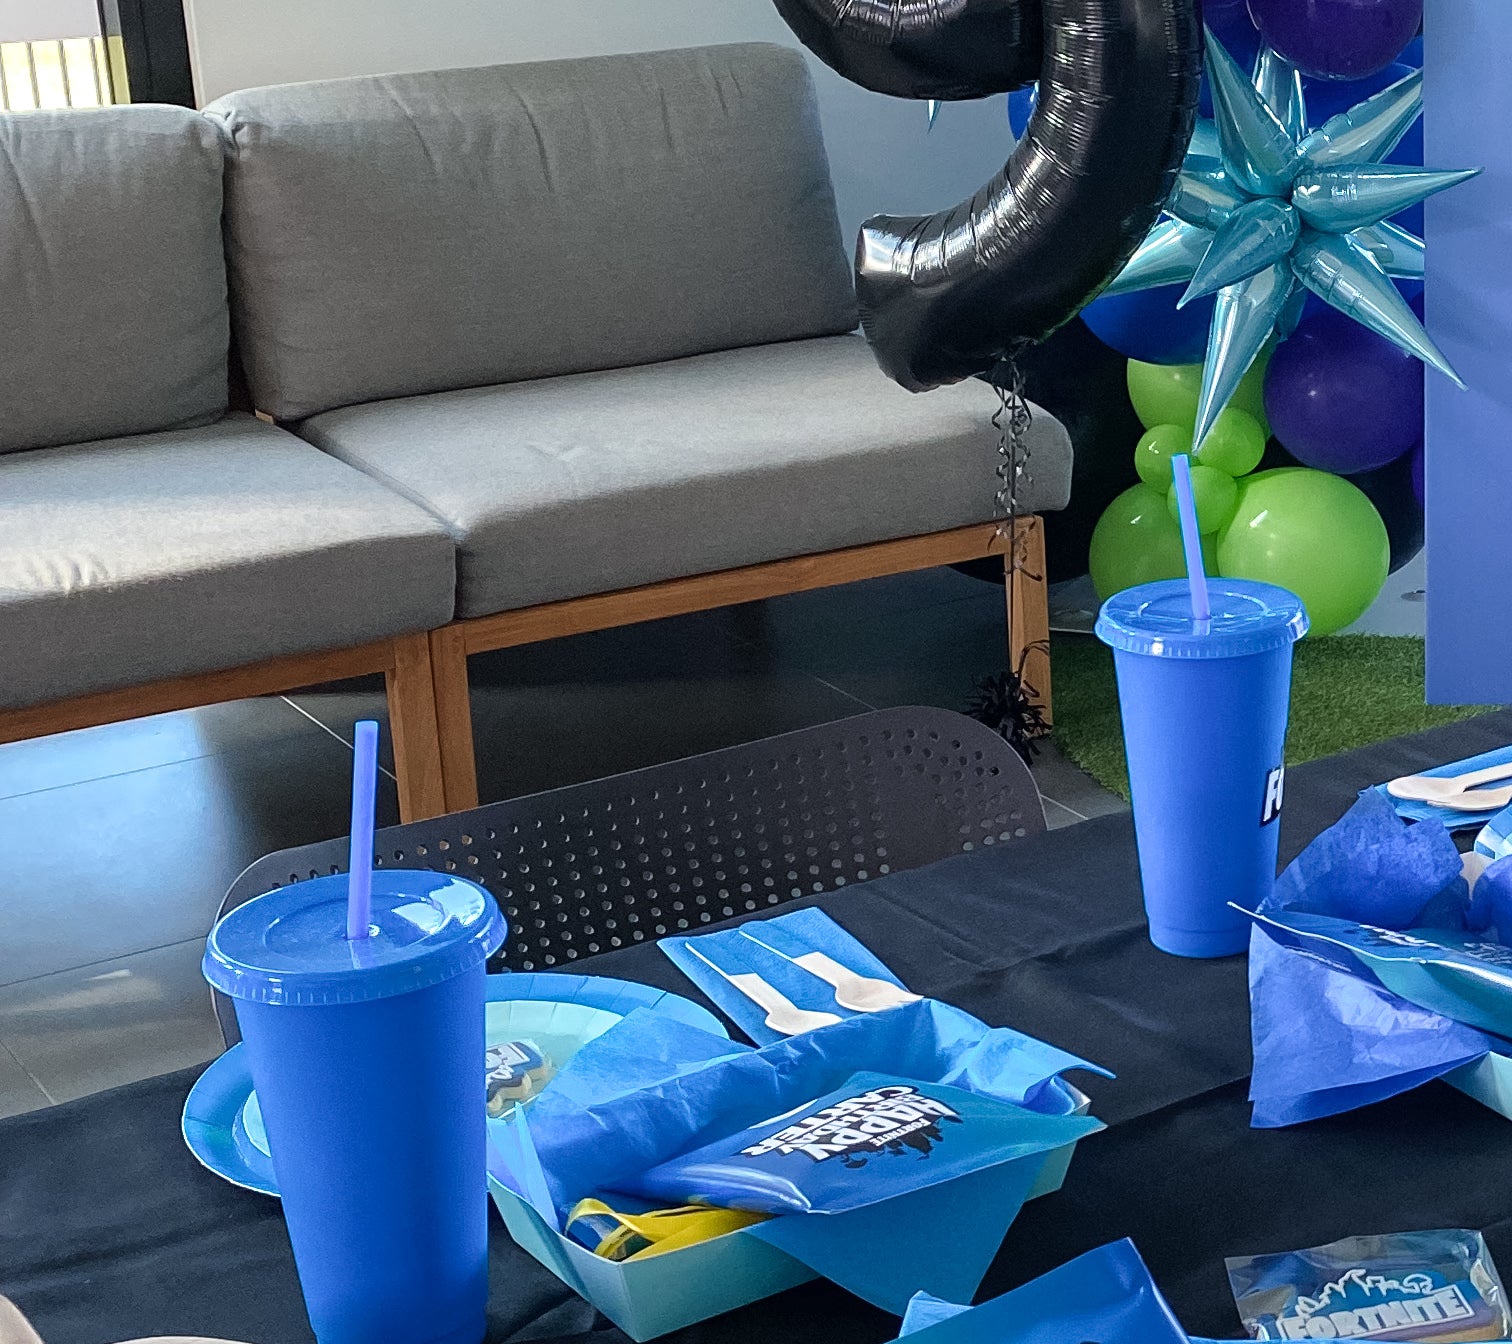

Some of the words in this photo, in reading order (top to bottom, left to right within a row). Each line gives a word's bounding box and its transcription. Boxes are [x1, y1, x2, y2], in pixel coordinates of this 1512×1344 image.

[741, 1085, 914, 1156] CARTER
[799, 1096, 961, 1161] HAPPY
[868, 1118, 932, 1147] FORTNITE
[1281, 1291, 1467, 1340] FORTNITE
